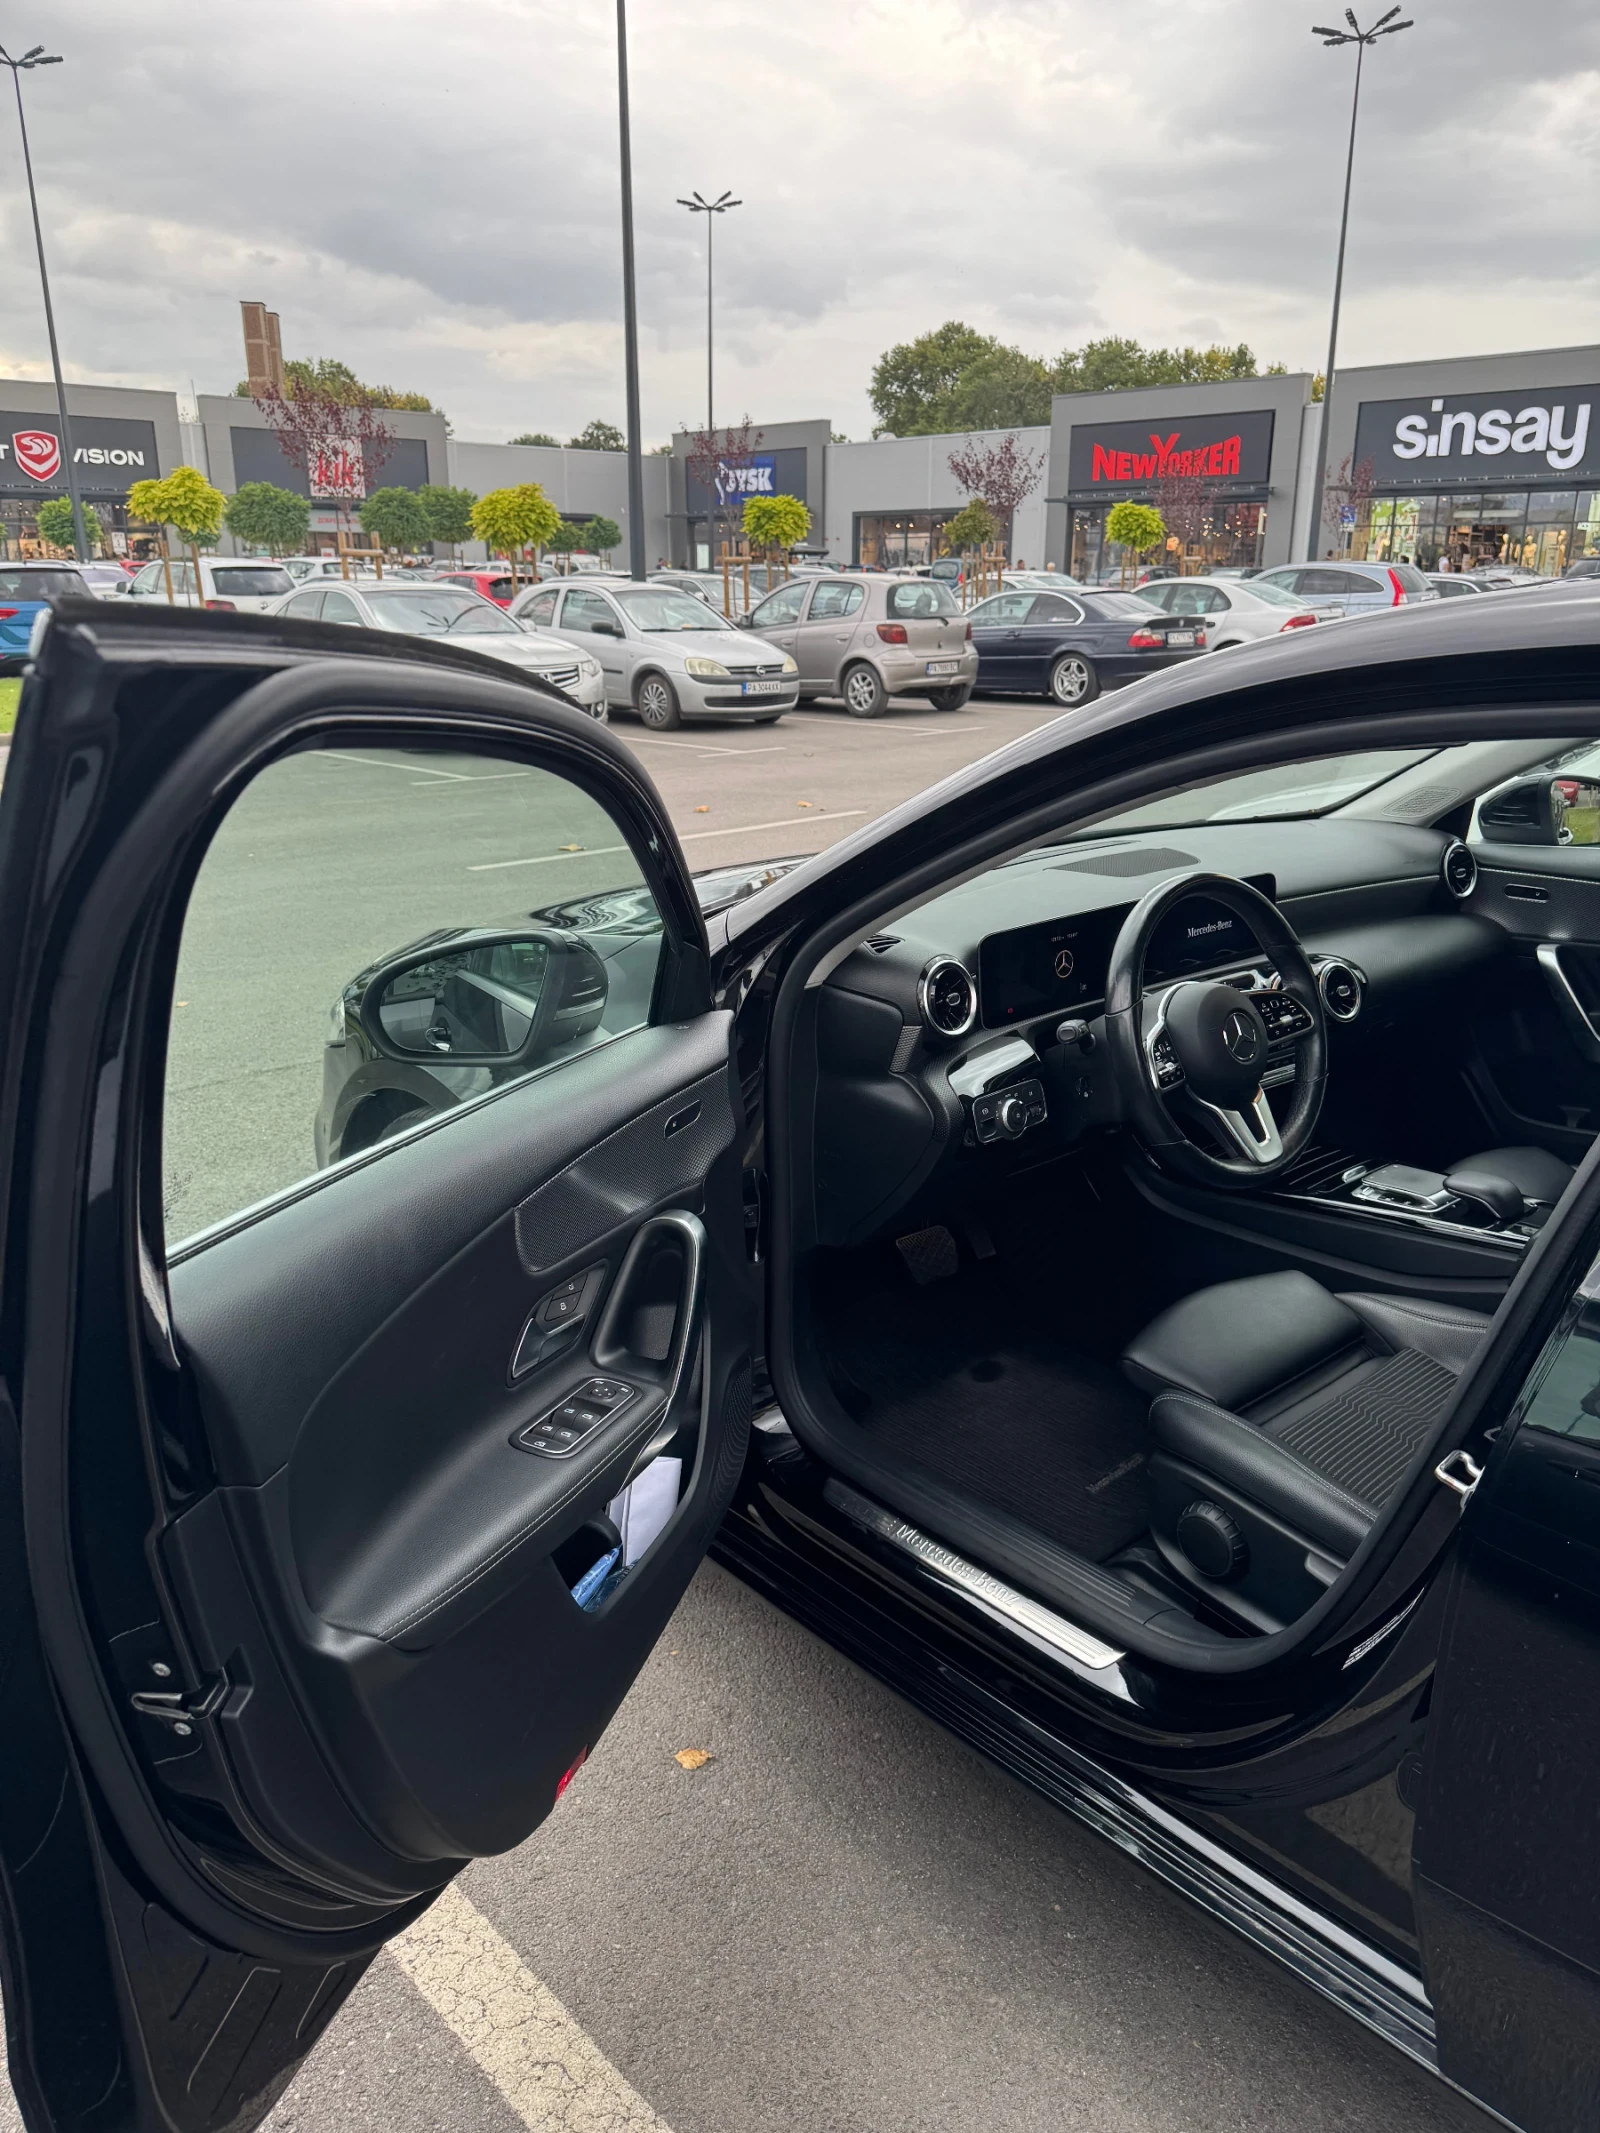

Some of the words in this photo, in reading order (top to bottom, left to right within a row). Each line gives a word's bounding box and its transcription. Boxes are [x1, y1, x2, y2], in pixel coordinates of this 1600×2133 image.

[1393, 399, 1591, 470] sinsay
[725, 467, 774, 493] JYSK
[1187, 920, 1232, 938] Mercedes-Benz
[896, 1524, 1020, 1608] Mercedes-Benz
